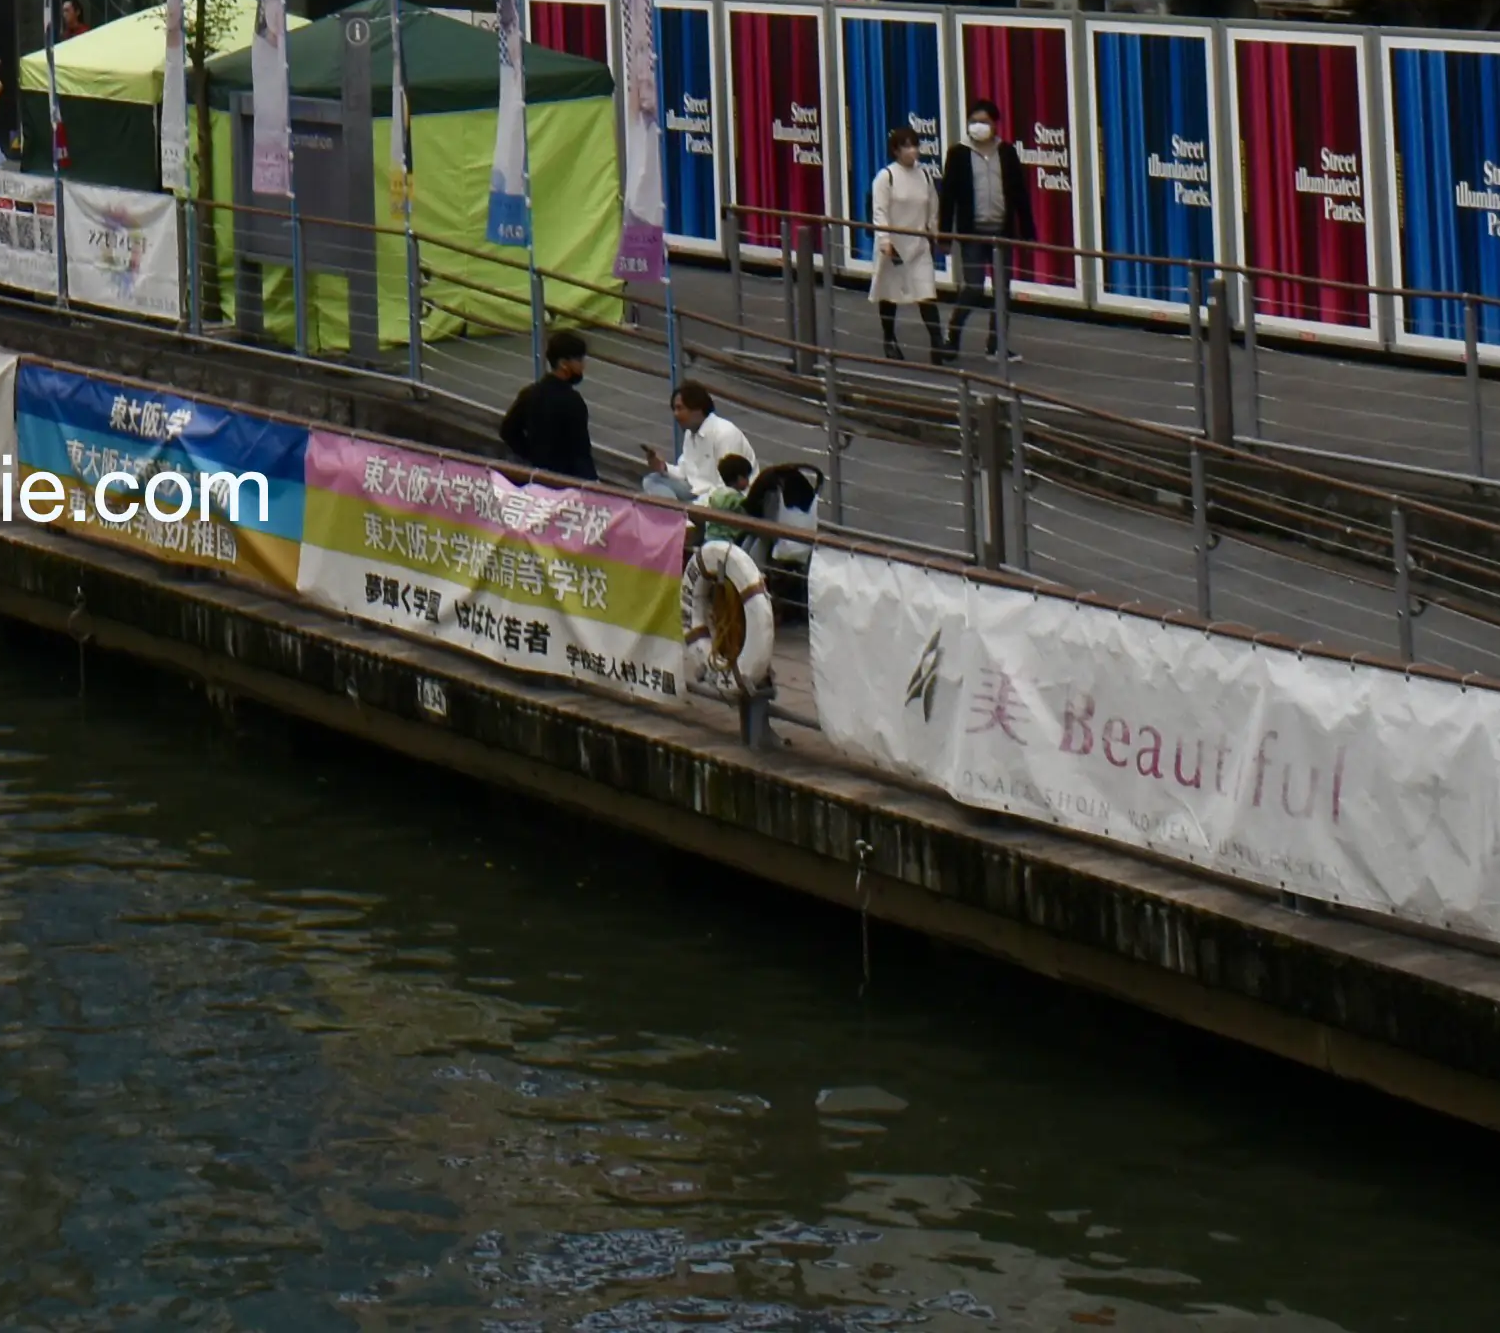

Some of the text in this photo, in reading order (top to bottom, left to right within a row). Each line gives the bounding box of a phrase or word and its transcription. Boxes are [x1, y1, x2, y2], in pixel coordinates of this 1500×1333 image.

[1171, 133, 1205, 161] Street
[1320, 147, 1358, 174] Street
[1173, 181, 1212, 208] Panels.
[1323, 196, 1365, 224] Panels.
[364, 571, 442, 625] 夢輝く学園
[565, 643, 677, 697] 学校法人村上学園
